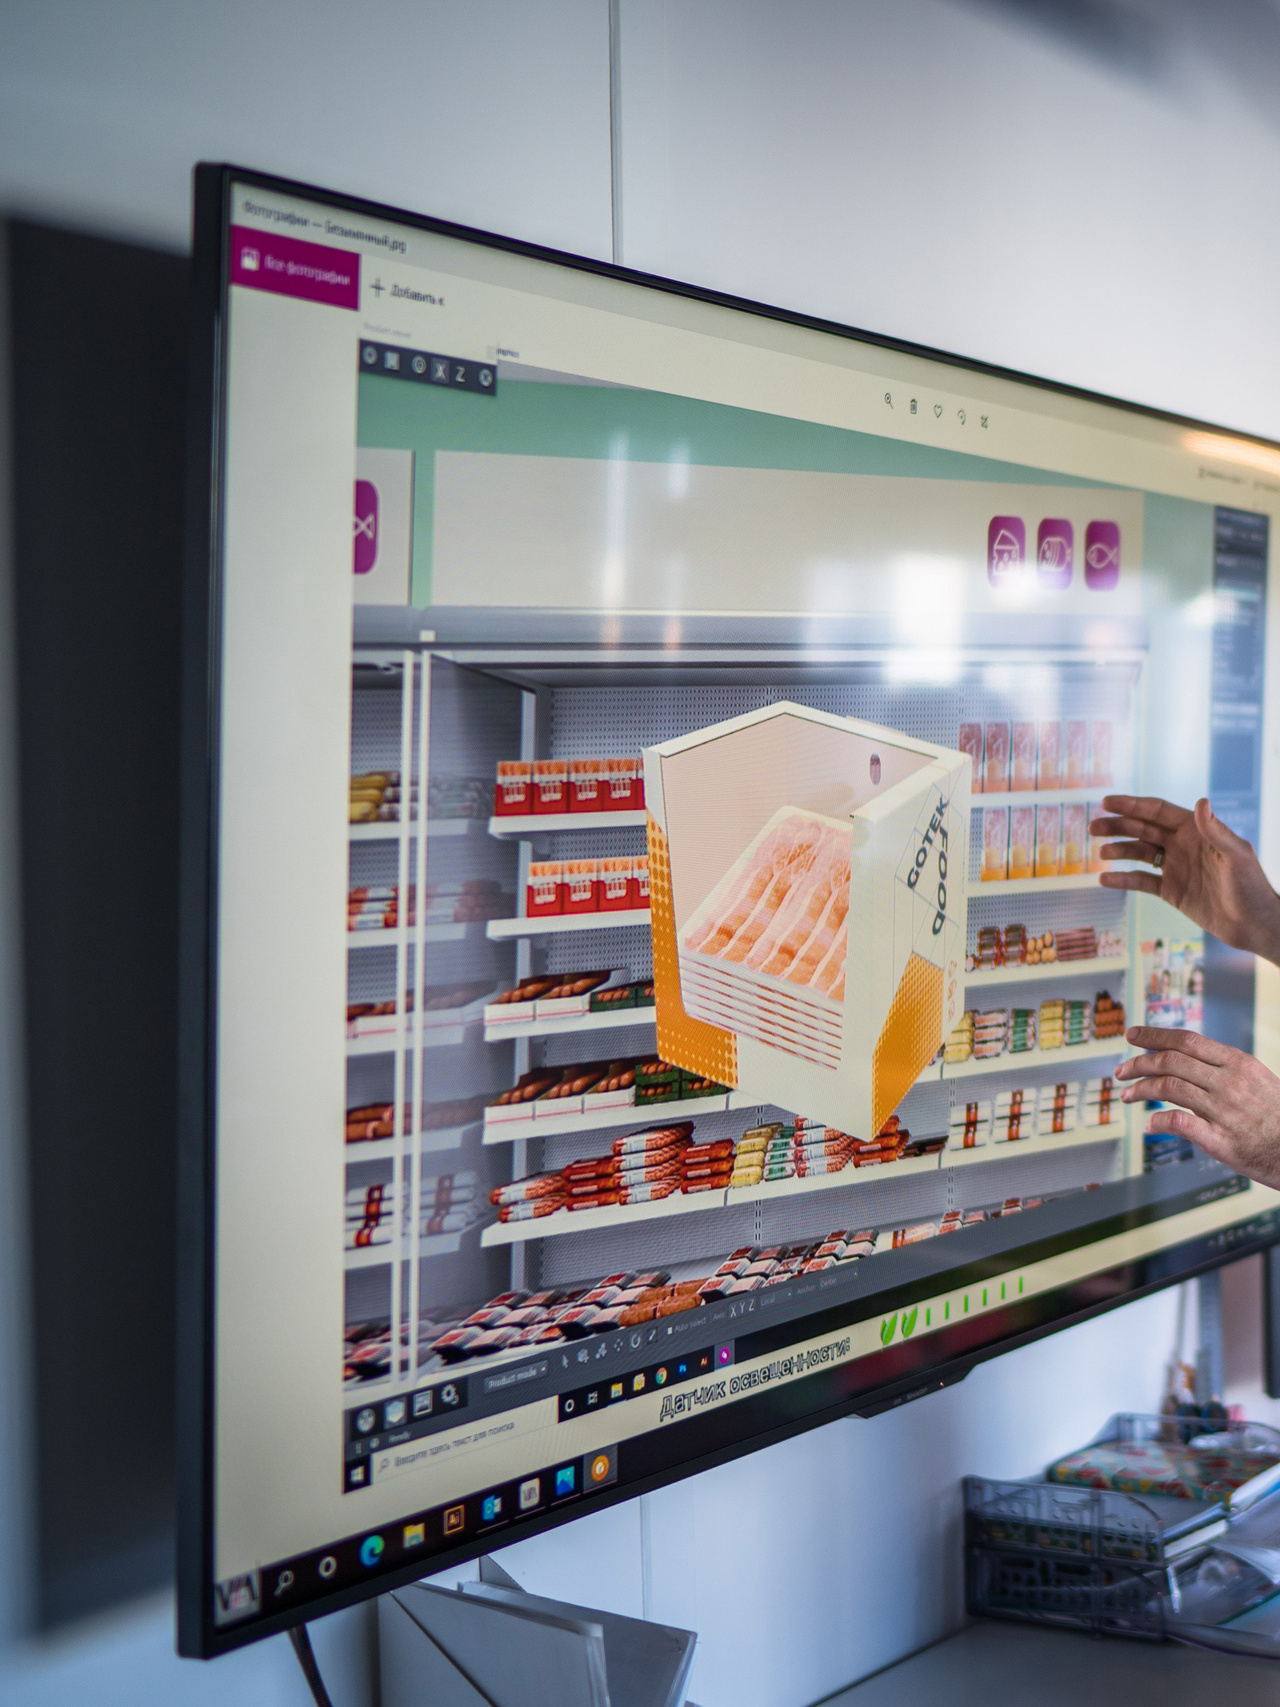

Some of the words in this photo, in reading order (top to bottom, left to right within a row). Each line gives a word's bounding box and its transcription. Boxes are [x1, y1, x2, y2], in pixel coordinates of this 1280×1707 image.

[244, 201, 309, 228] Фотографии
[264, 254, 286, 272] Все
[286, 260, 350, 285] фотографии
[391, 284, 436, 306] Добавить
[907, 795, 950, 890] GOTEK
[931, 823, 949, 936] FOOD
[730, 1304, 737, 1318] X
[740, 1301, 746, 1313] Y
[748, 1299, 755, 1311] Z
[488, 1373, 516, 1389] Product
[517, 1367, 537, 1381] mode
[660, 1380, 727, 1422] Датчик
[729, 1336, 851, 1395] освещенности:
[395, 1449, 428, 1467] Введите
[429, 1443, 451, 1456] здесь
[452, 1435, 472, 1447] текст
[472, 1430, 487, 1442] для
[488, 1422, 515, 1436] поиска
